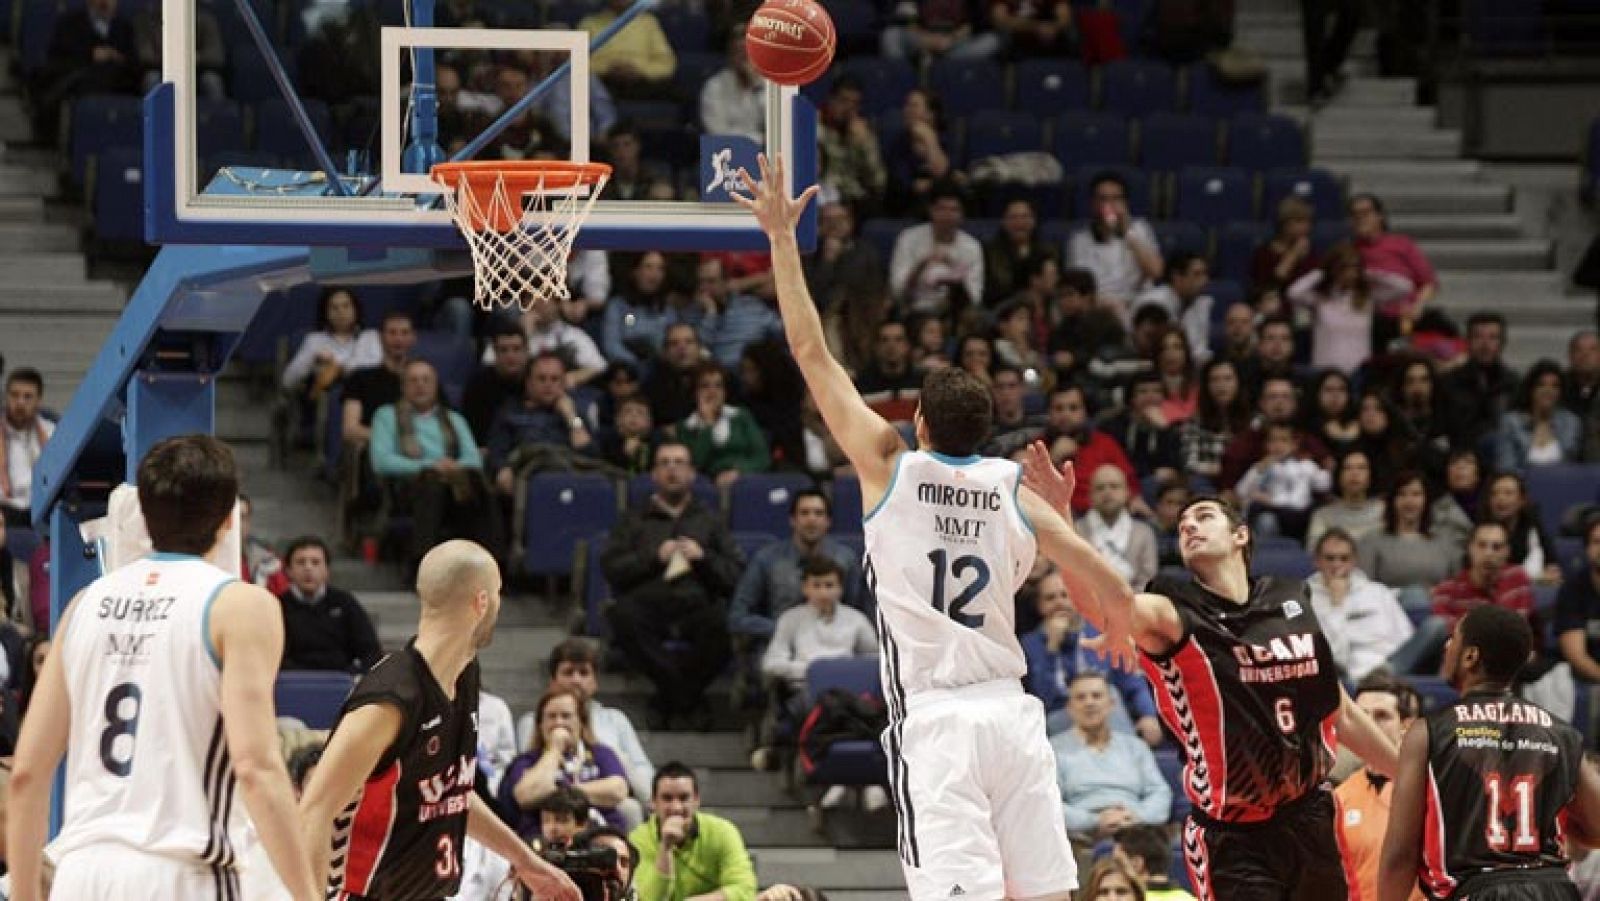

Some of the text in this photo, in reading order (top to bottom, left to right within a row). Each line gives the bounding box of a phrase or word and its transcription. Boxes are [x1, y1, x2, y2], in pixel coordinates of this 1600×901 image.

[918, 481, 1001, 511] MIROTIĆ
[934, 514, 986, 537] MMT
[927, 548, 991, 629] 12
[99, 682, 142, 778] 8
[1274, 697, 1297, 734] 6
[1454, 701, 1553, 727] RAGLAND
[1485, 774, 1539, 851] 11
